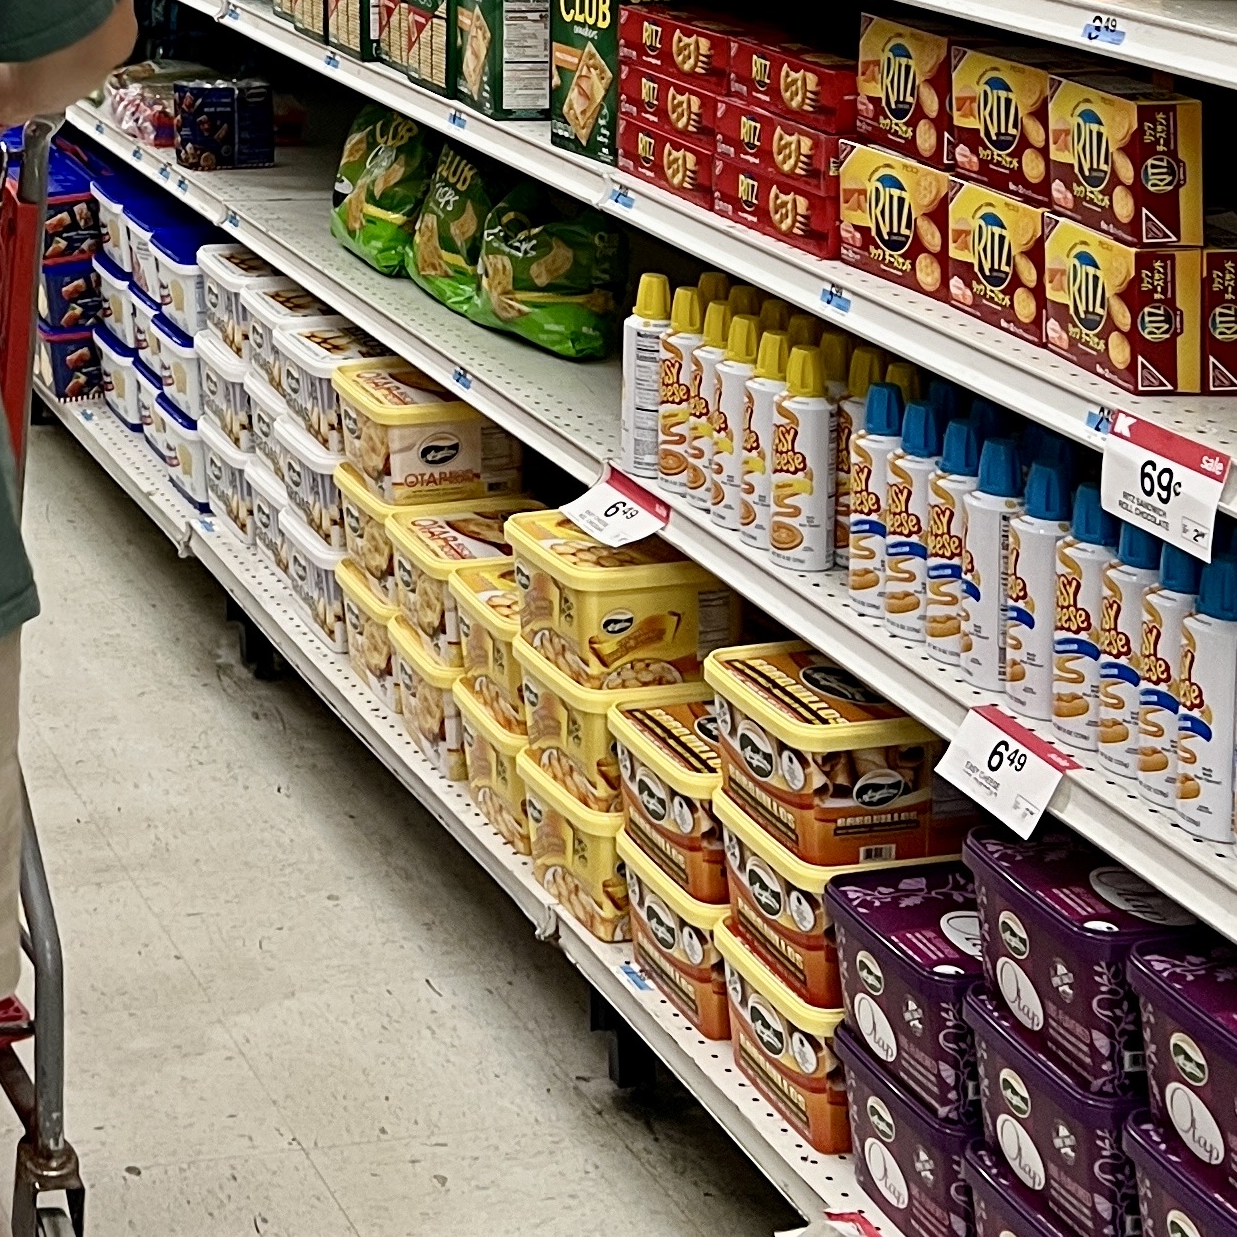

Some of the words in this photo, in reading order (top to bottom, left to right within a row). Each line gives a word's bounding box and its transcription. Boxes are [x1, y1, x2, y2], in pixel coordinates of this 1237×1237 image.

[642, 20, 663, 48] RITZ
[751, 53, 771, 83] RITZ
[882, 49, 916, 109] RITZ
[640, 75, 660, 104] RITZ
[979, 82, 1018, 141] RITZ
[637, 130, 656, 160] RITZ
[740, 114, 761, 145] RITZ
[1073, 115, 1109, 177] RITZ
[738, 171, 759, 204] RITZ
[1146, 157, 1175, 193] RITZ
[870, 179, 912, 240] RITZ
[973, 216, 1012, 277] RITZ
[1069, 257, 1106, 319] RITZ
[1143, 306, 1171, 340] RITZ
